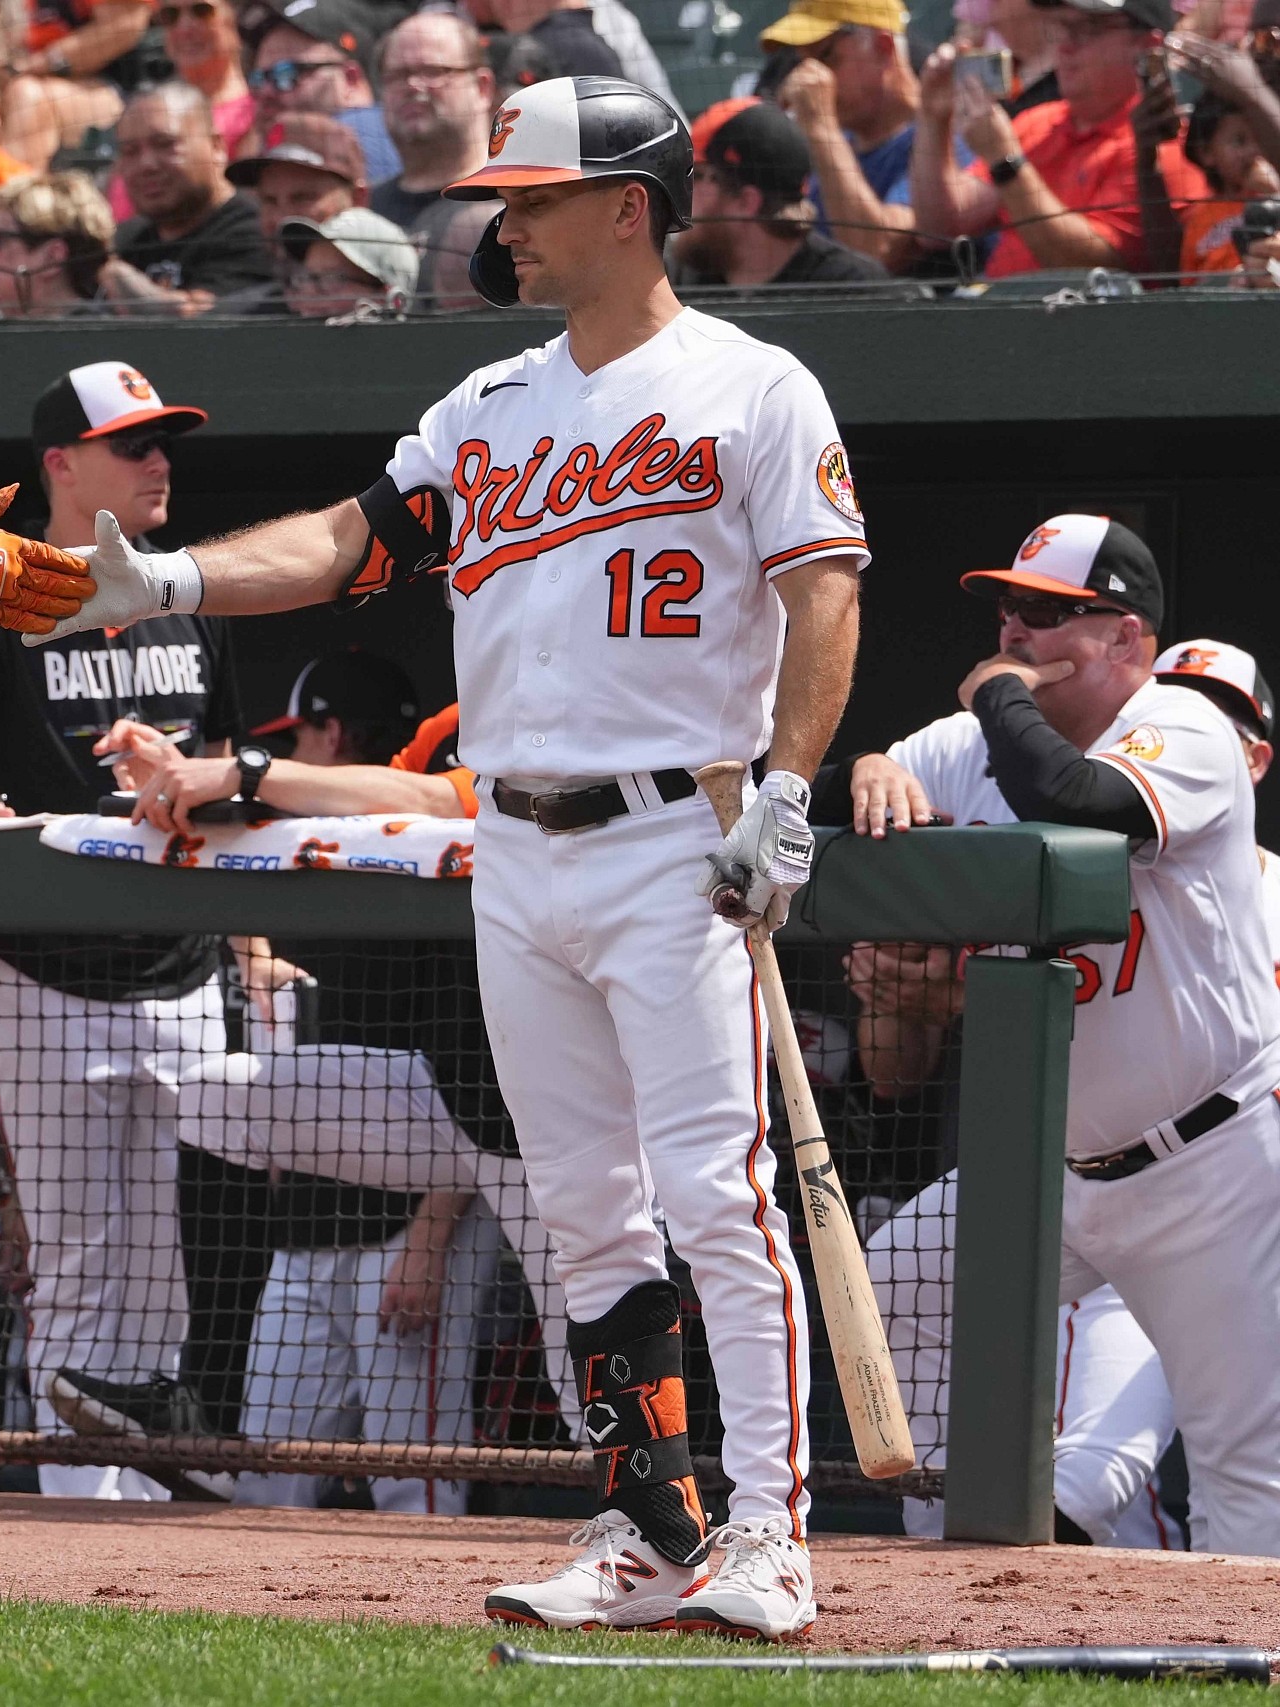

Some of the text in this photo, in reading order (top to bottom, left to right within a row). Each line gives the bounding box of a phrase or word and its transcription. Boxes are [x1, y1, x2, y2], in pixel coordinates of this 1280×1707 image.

[447, 411, 724, 566] Orioles
[605, 547, 705, 638] 12
[43, 644, 207, 701] BALTIMORE
[78, 838, 144, 862] GEICO
[862, 1362, 875, 1386] ADAM
[868, 1388, 885, 1422] FRAZIER
